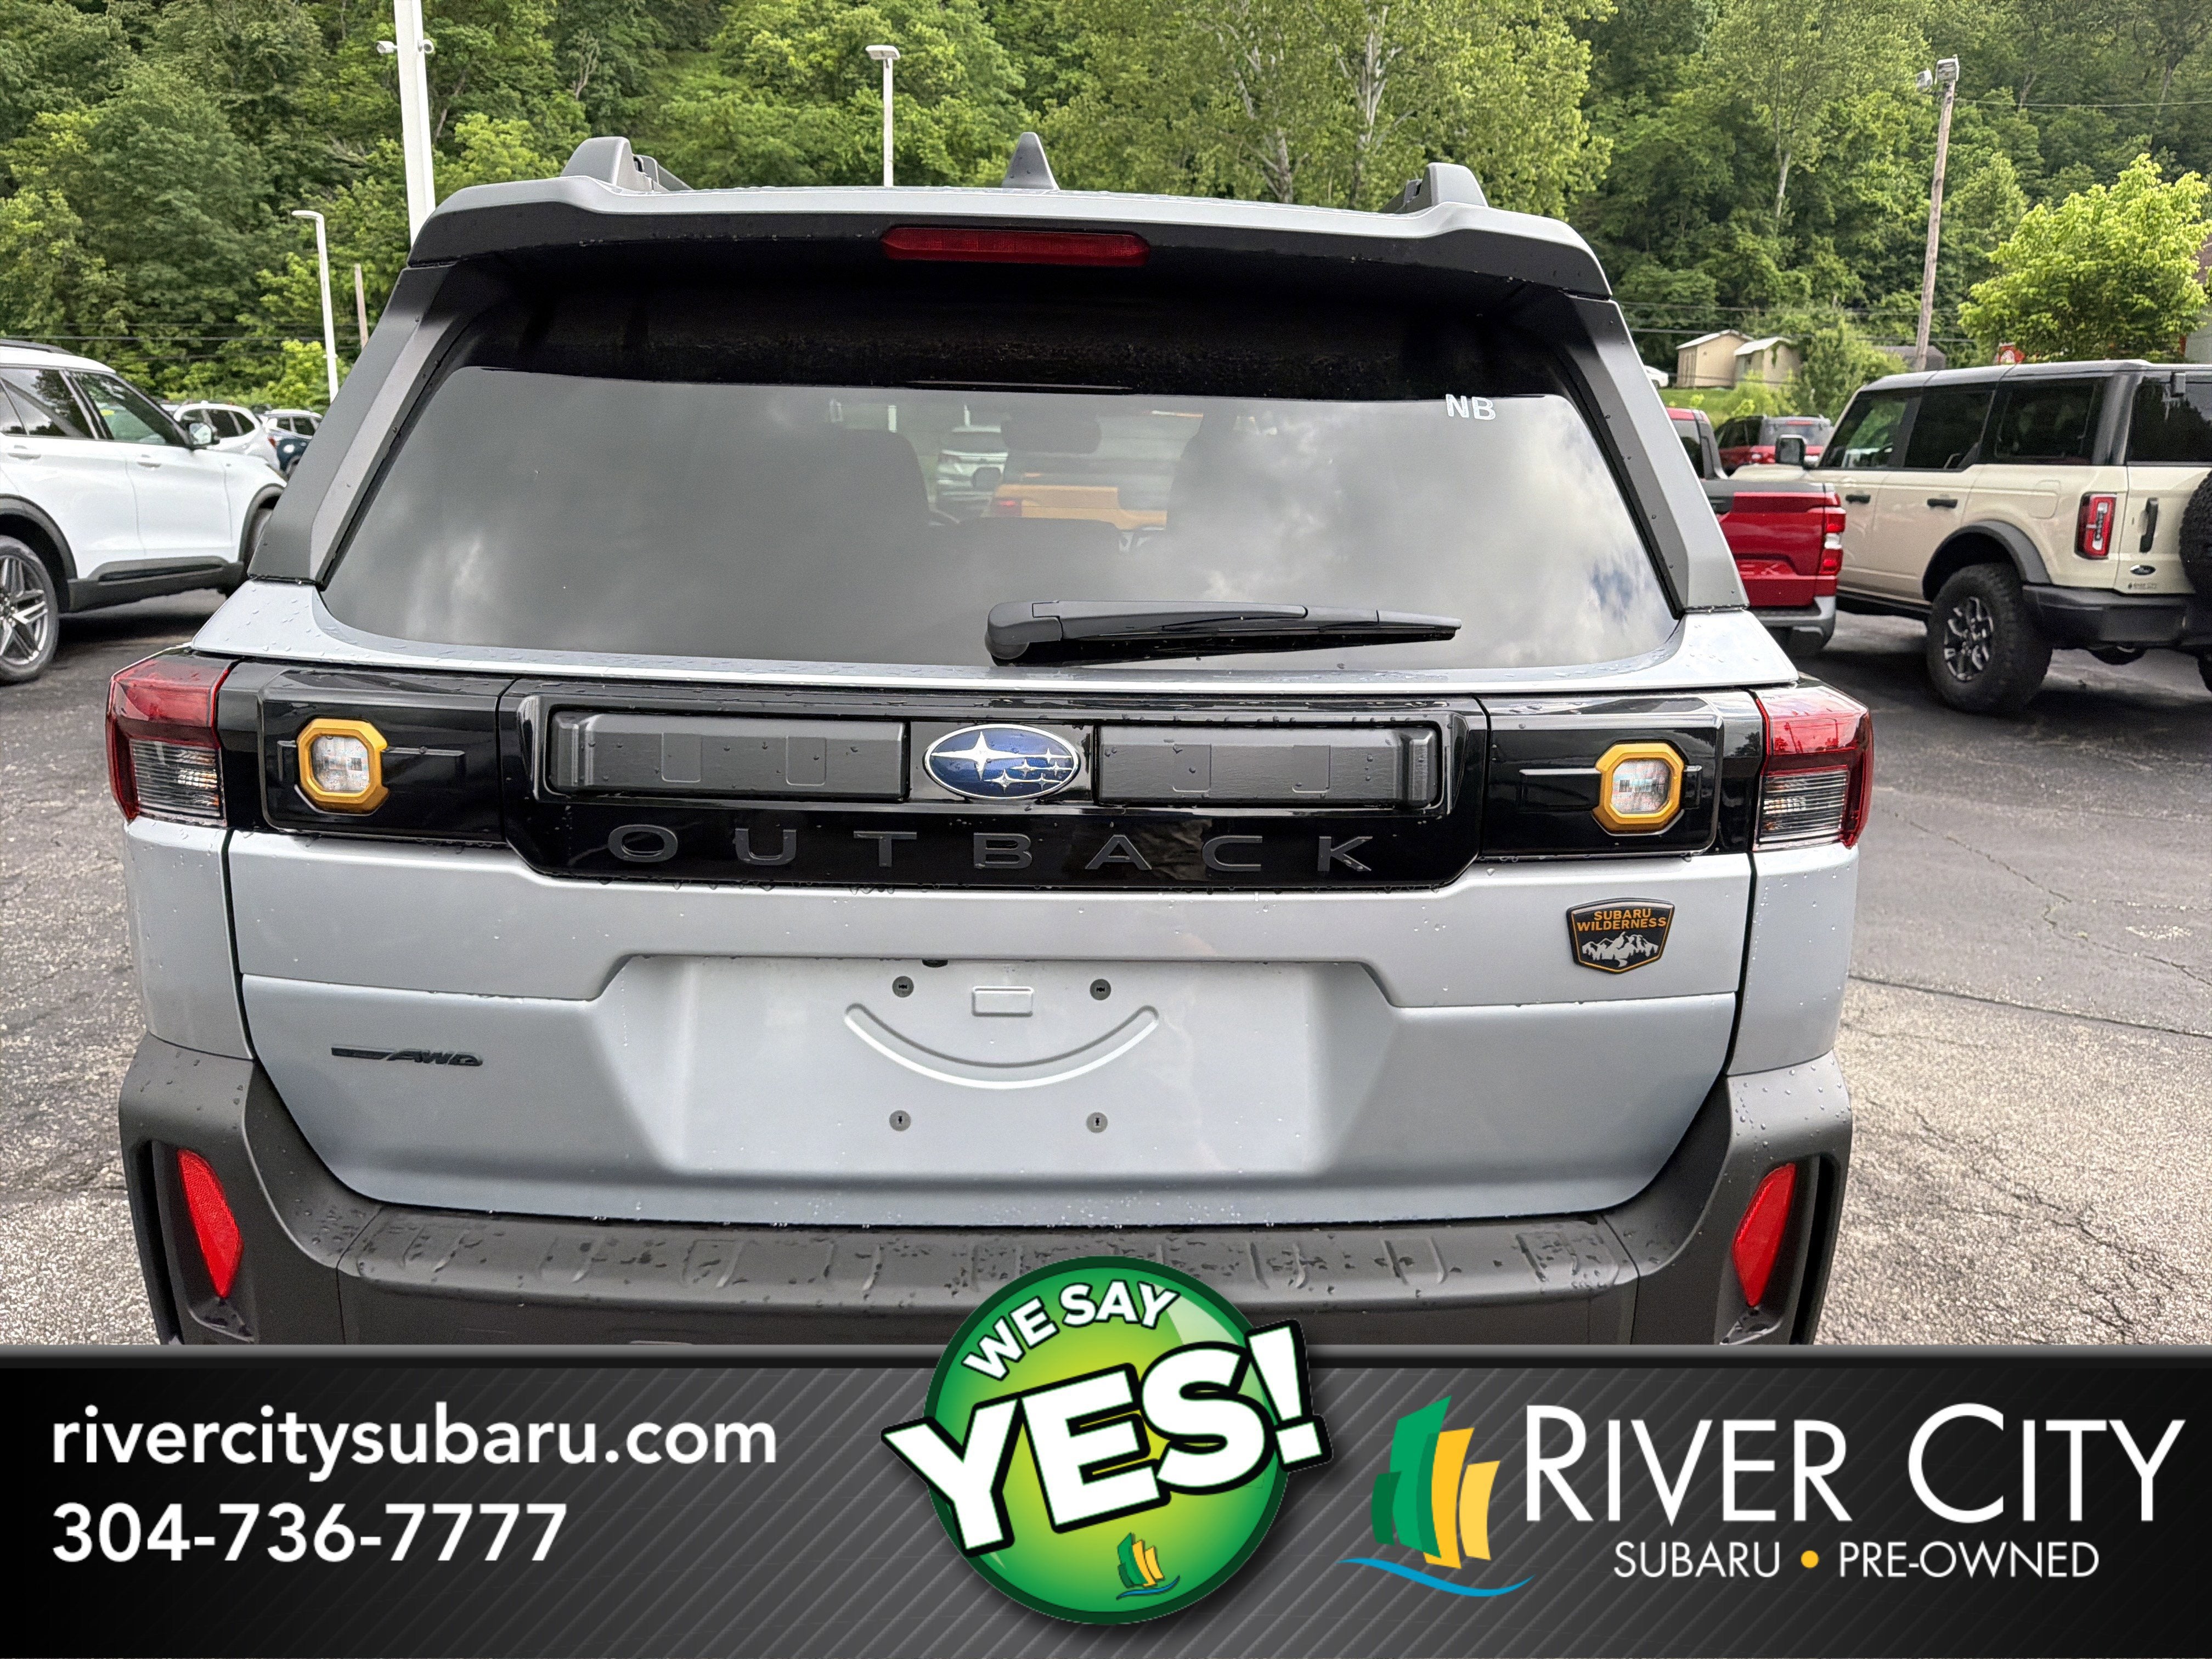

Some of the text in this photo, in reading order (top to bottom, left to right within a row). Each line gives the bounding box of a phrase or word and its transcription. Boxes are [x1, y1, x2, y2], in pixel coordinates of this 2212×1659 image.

[1446, 394, 1496, 420] NB
[607, 823, 1373, 872] OUTBACK
[1594, 909, 1651, 921] SUBARU
[1577, 917, 1667, 932] WILDERNESS
[386, 1050, 483, 1066] AWD
